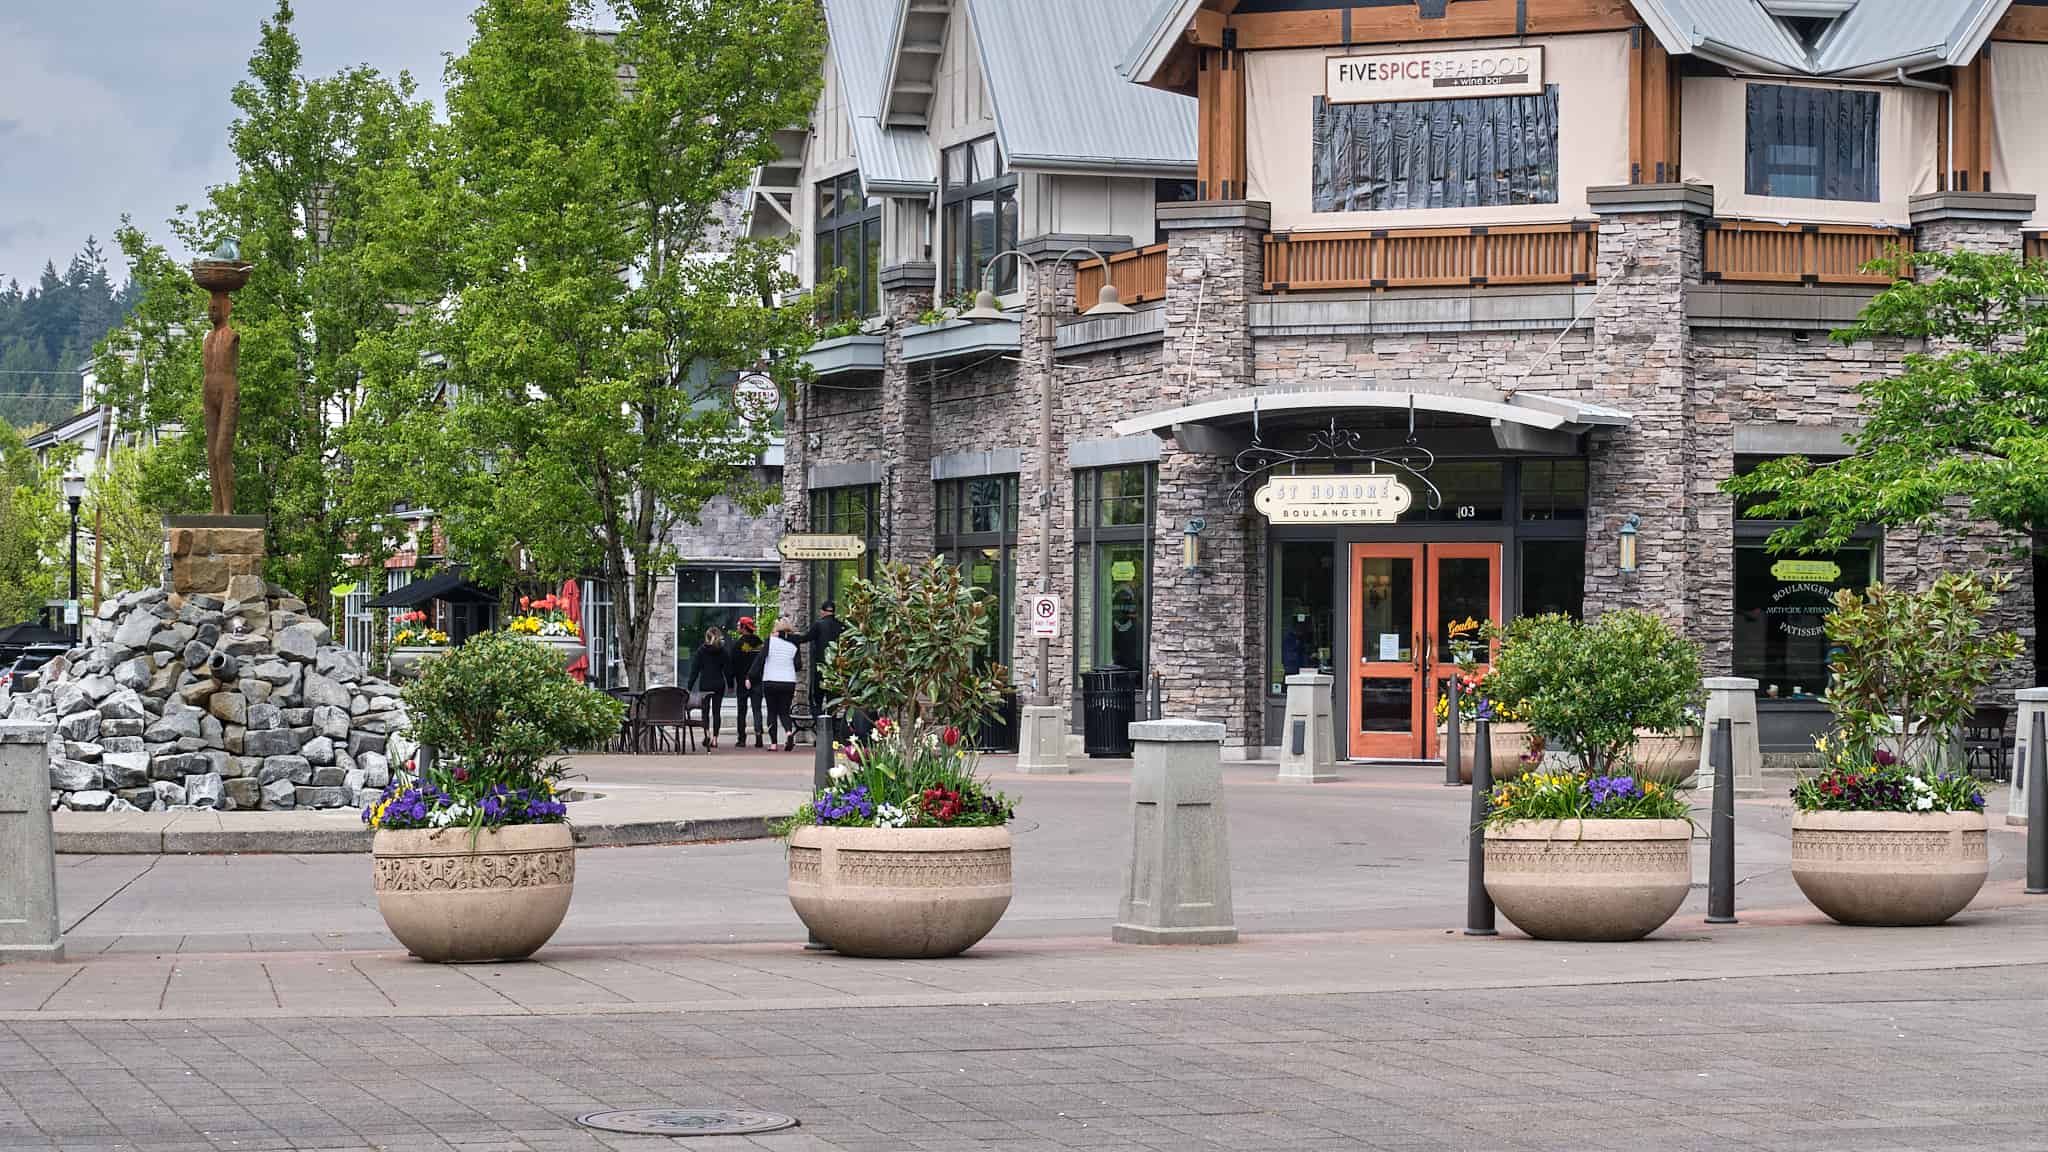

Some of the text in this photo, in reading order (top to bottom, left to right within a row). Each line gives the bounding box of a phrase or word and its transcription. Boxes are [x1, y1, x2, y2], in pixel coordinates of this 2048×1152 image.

[1461, 77, 1483, 86] wine
[1485, 75, 1503, 85] bar
[1283, 507, 1383, 518] BOULANGERIE
[1772, 583, 1835, 601] BOULANGERI
